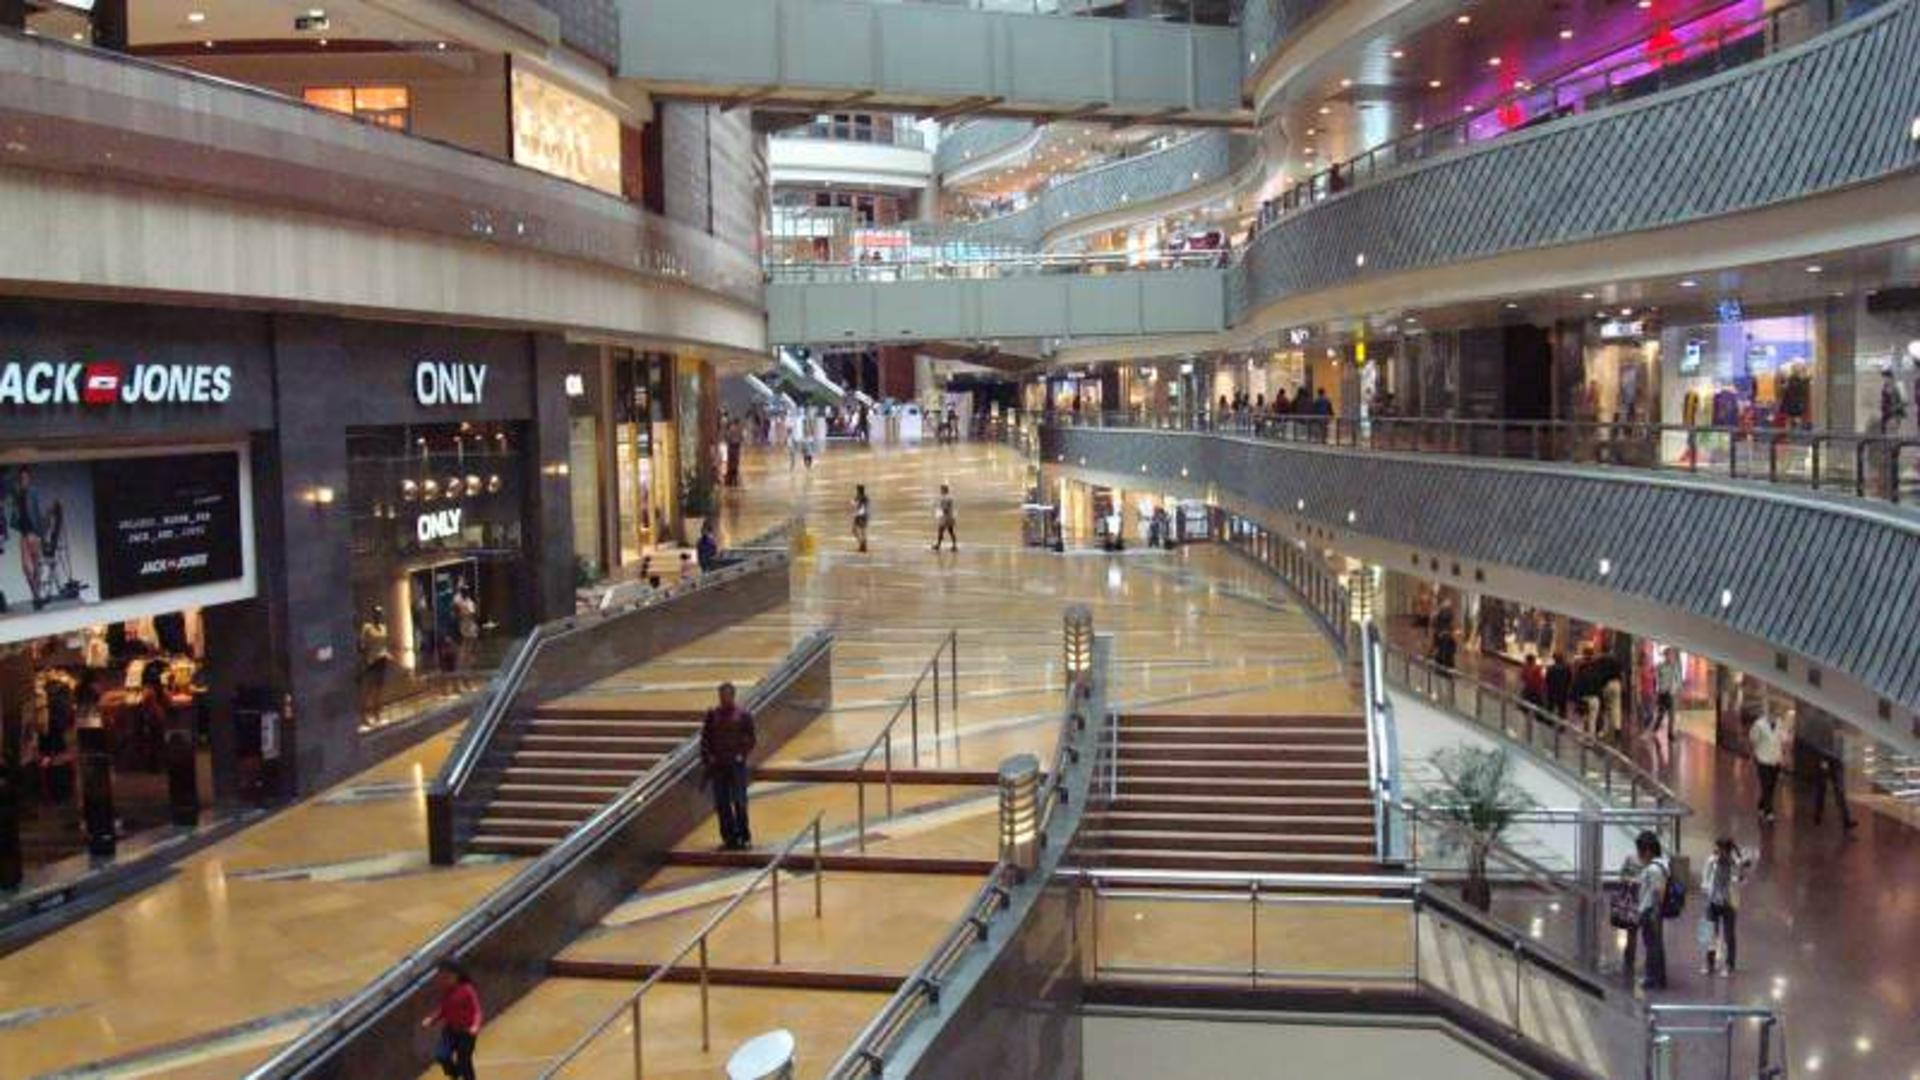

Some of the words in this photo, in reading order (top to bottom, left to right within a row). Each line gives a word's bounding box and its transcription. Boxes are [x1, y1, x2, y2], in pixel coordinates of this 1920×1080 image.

[122, 364, 232, 403] JONES
[416, 361, 487, 405] ONLY
[417, 508, 462, 541] ONLY
[140, 558, 167, 574] JACK
